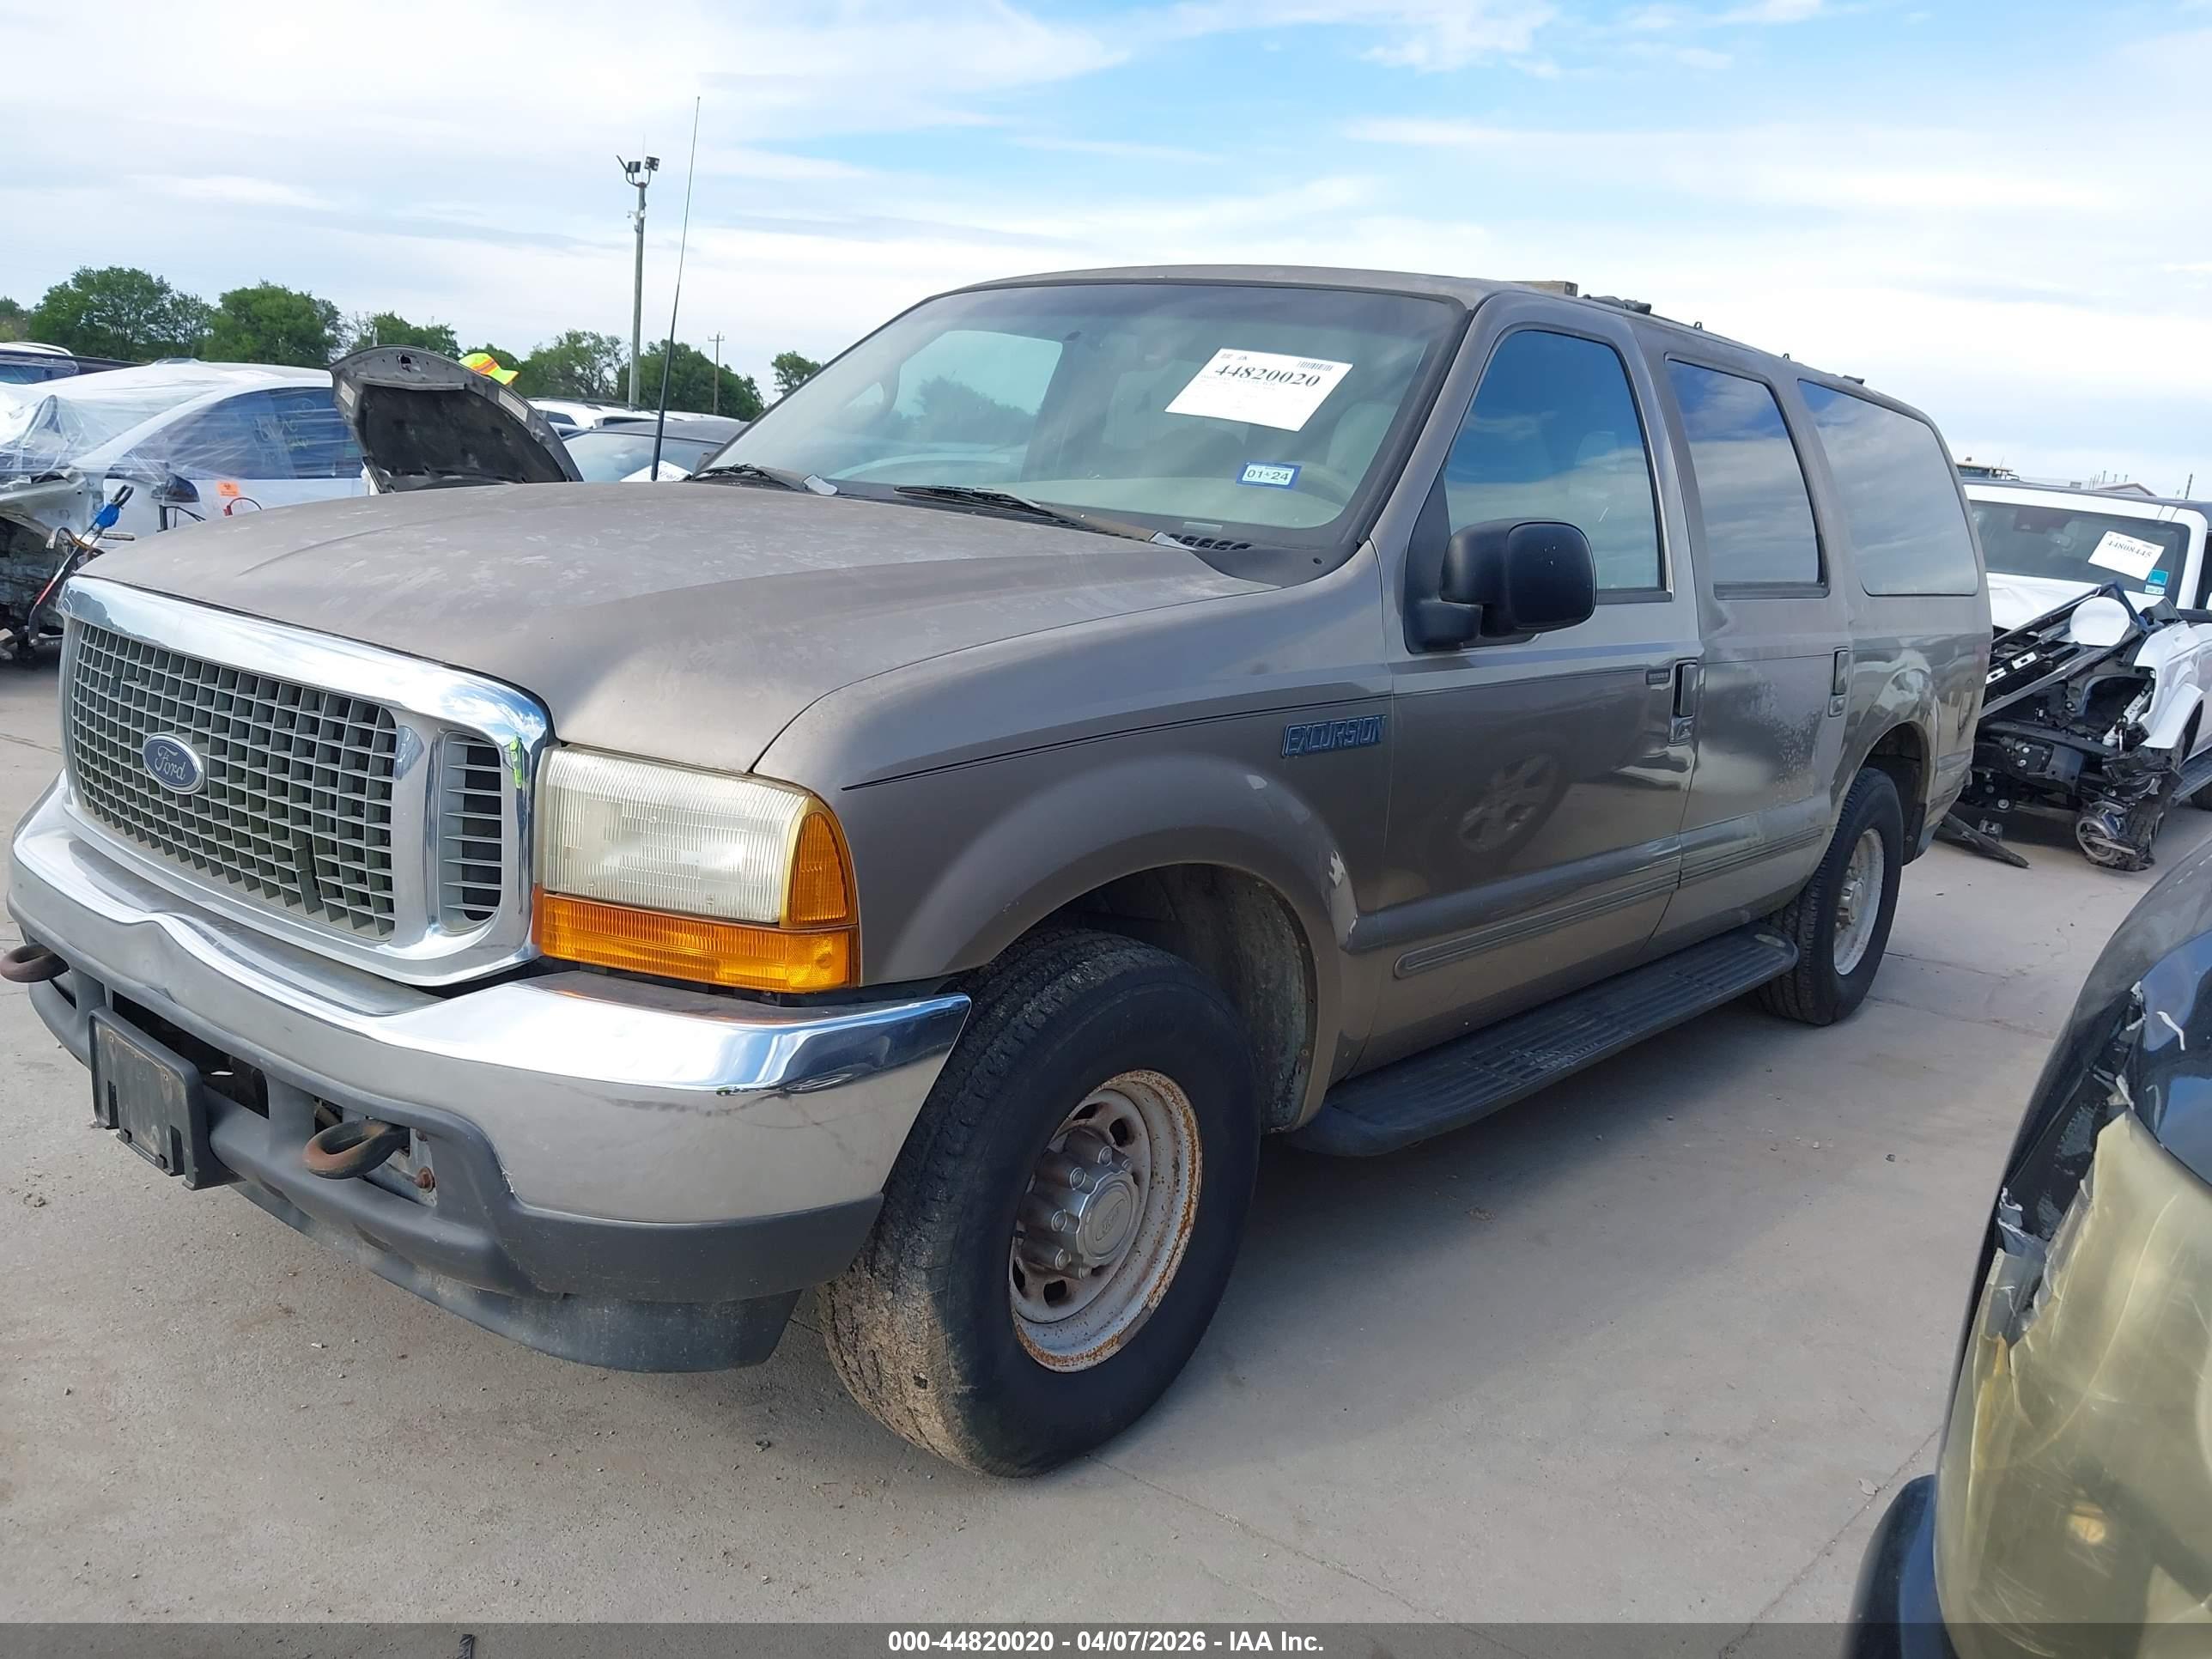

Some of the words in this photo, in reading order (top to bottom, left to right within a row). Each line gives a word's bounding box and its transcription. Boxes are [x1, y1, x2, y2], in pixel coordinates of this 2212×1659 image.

[1214, 364, 1321, 387] 44820020
[1284, 714, 1387, 756] EXCURSION
[155, 745, 186, 781] Ford
